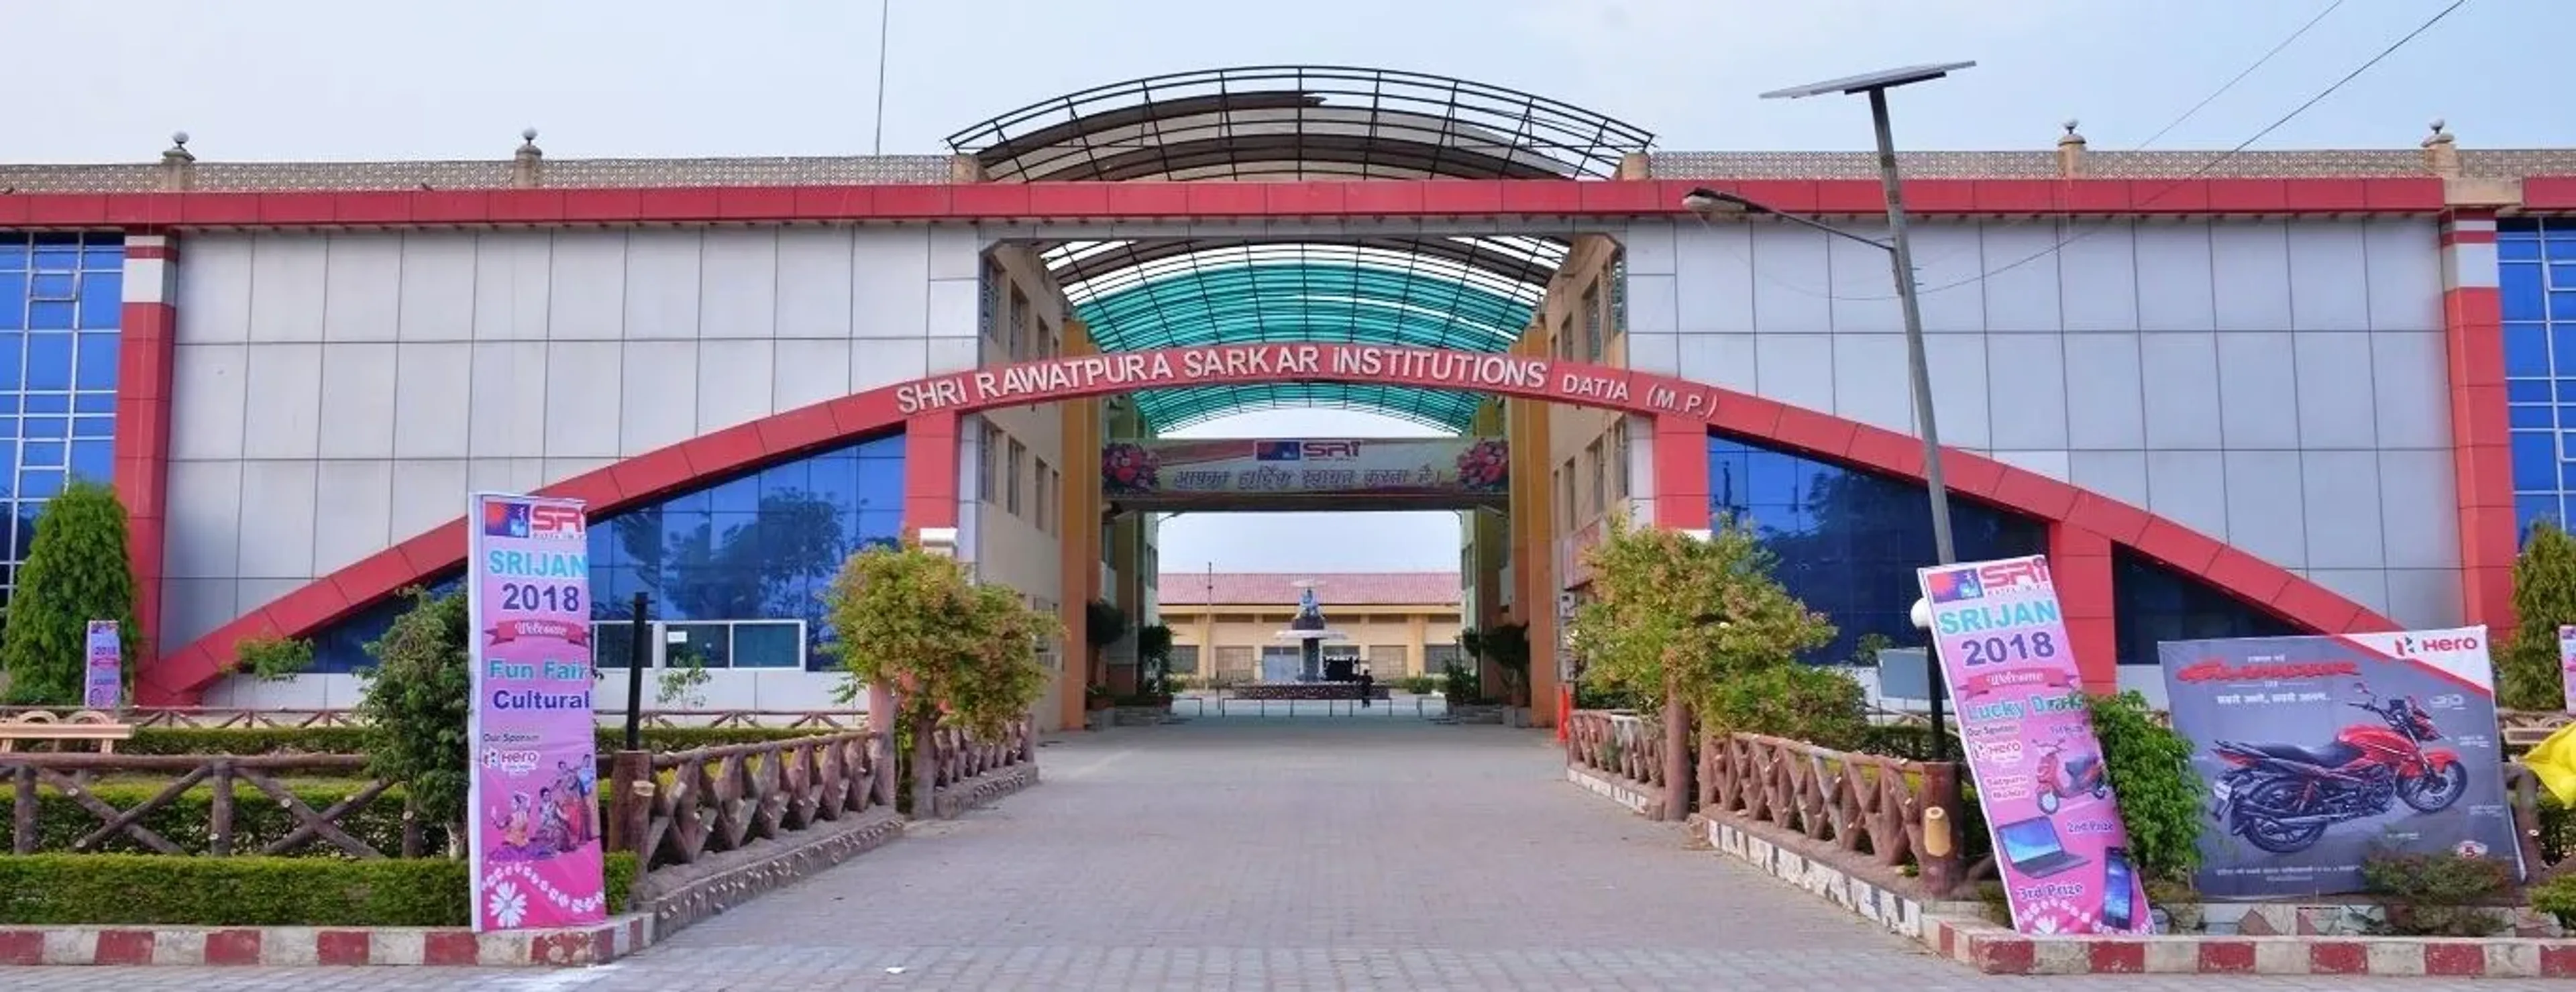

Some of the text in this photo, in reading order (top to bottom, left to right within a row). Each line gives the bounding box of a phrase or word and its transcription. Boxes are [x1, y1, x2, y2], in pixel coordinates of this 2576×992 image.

[897, 379, 967, 415] SHRI
[976, 352, 1174, 399] RAWATPURA
[1184, 346, 1319, 378] SARKAR
[1333, 346, 1548, 388] INSTITUTIONS
[1562, 374, 1629, 400] DATIA
[489, 550, 588, 577] SRIJAN
[502, 583, 580, 612] 2018
[1938, 599, 2058, 635] SRIJAN
[1961, 631, 2055, 666] 2018
[490, 658, 586, 679] Fun Fair
[493, 690, 590, 709] Cultural
[1966, 700, 2025, 720] Lucky
[2017, 883, 2083, 900] 3rd Prize
